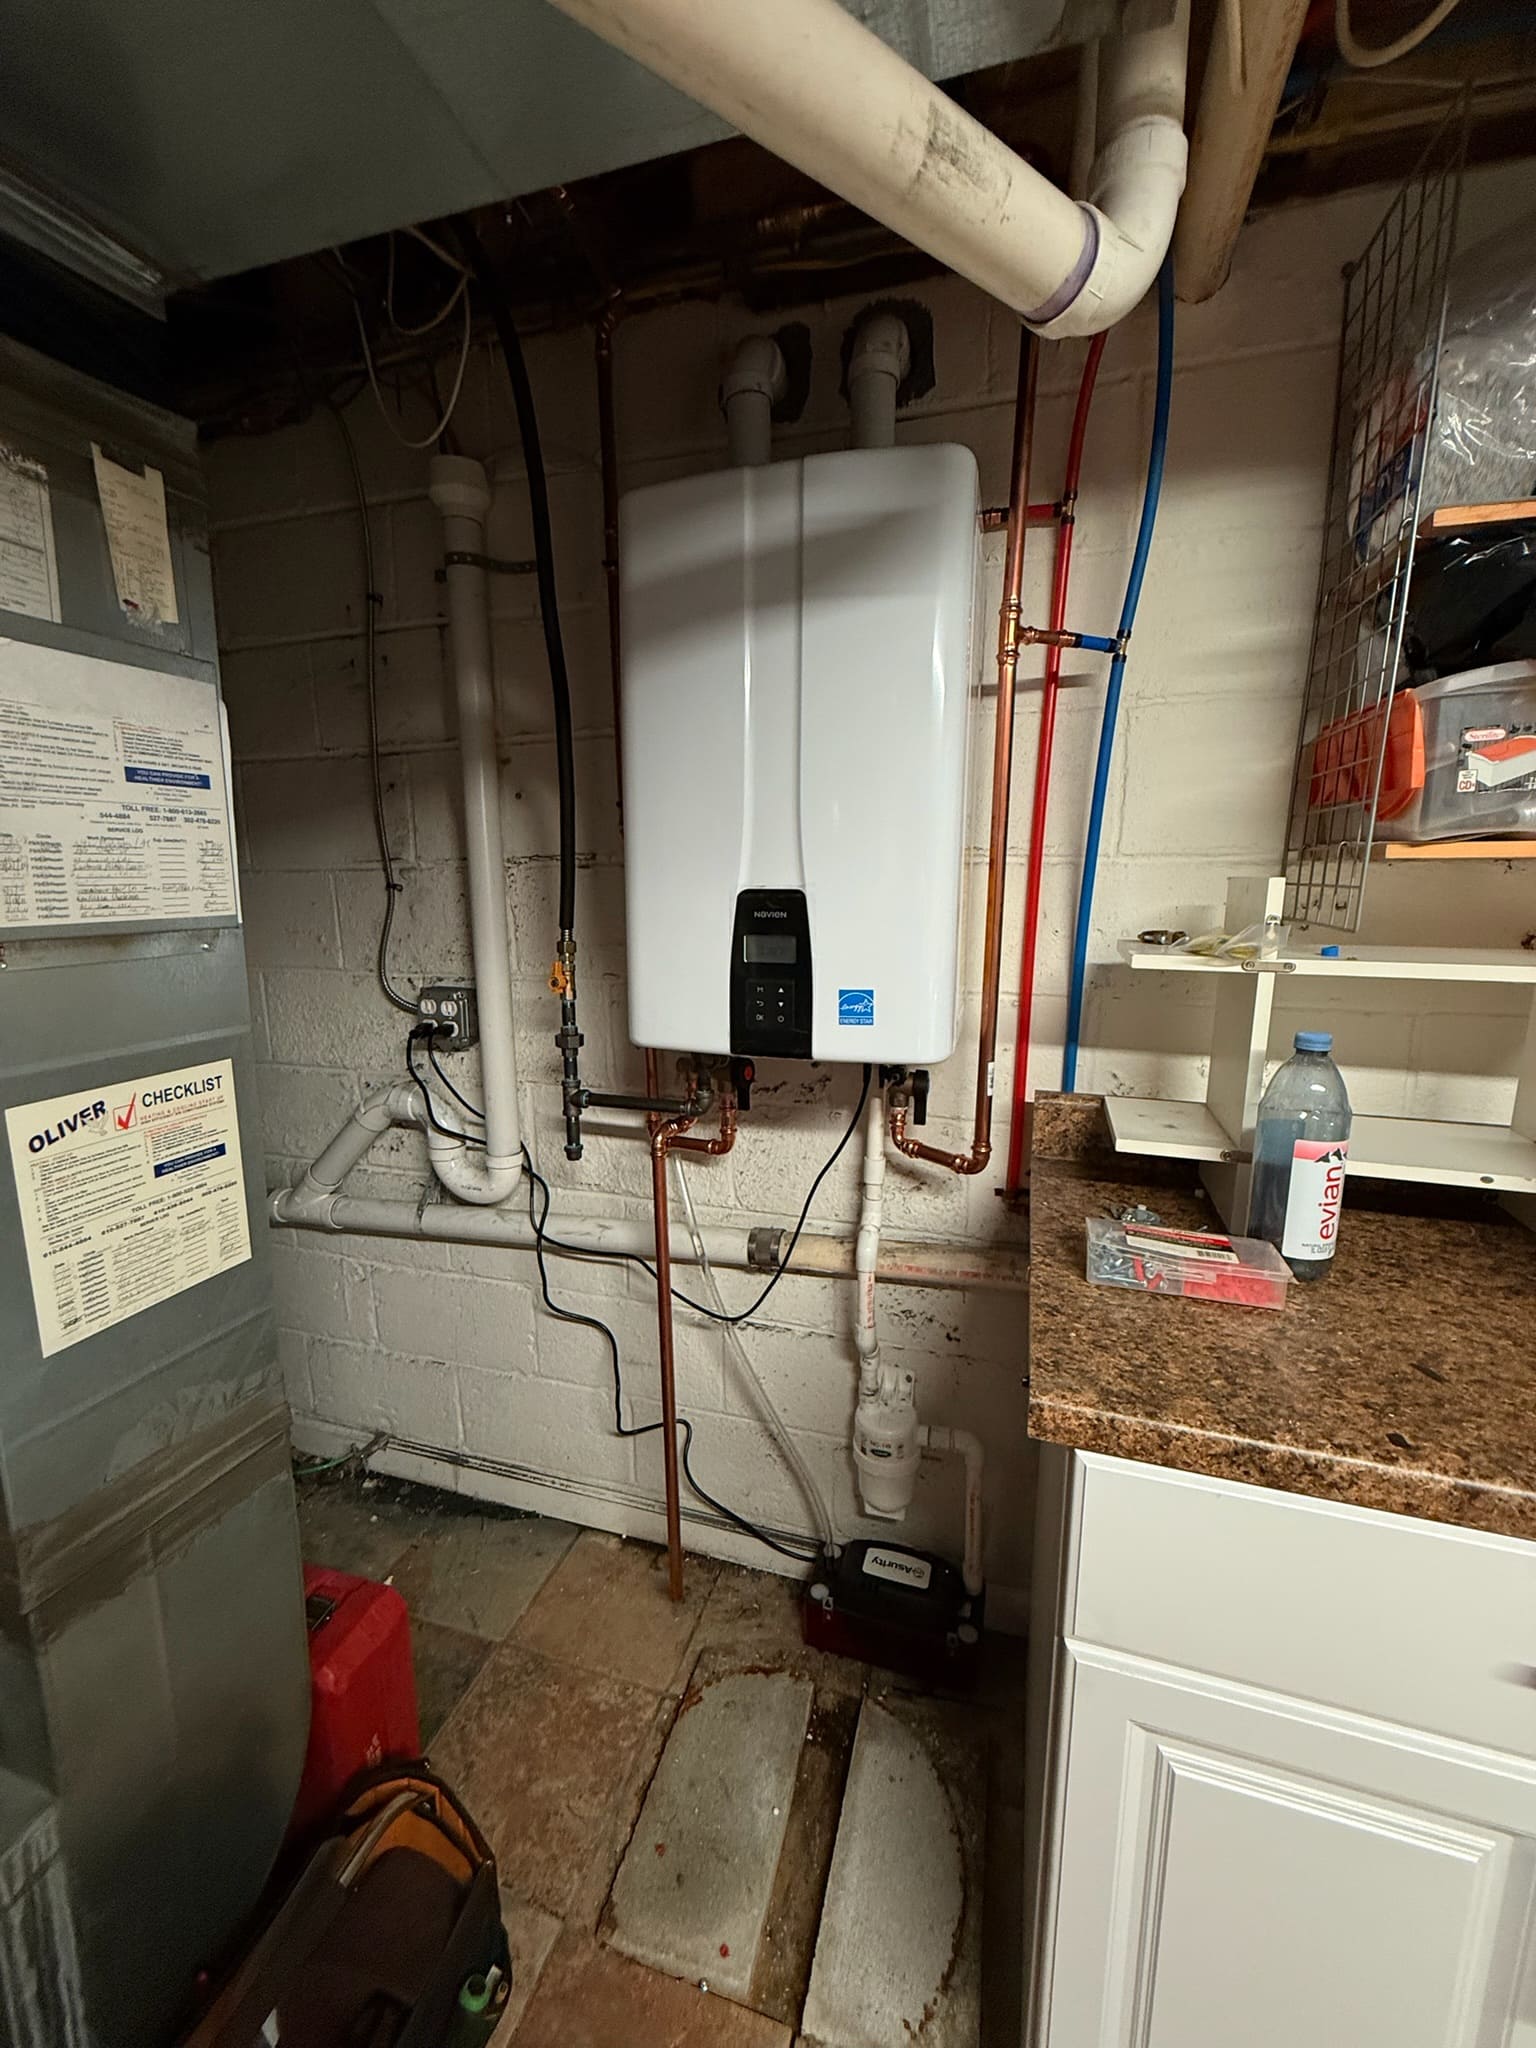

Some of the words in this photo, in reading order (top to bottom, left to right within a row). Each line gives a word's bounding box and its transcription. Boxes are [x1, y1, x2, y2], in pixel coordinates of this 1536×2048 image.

[122, 804, 139, 812] TOLL
[142, 1075, 223, 1107] CHECKLIST
[28, 1099, 106, 1153] OLIVER
[1318, 1165, 1343, 1240] evian
[871, 1556, 913, 1574] Asurity
